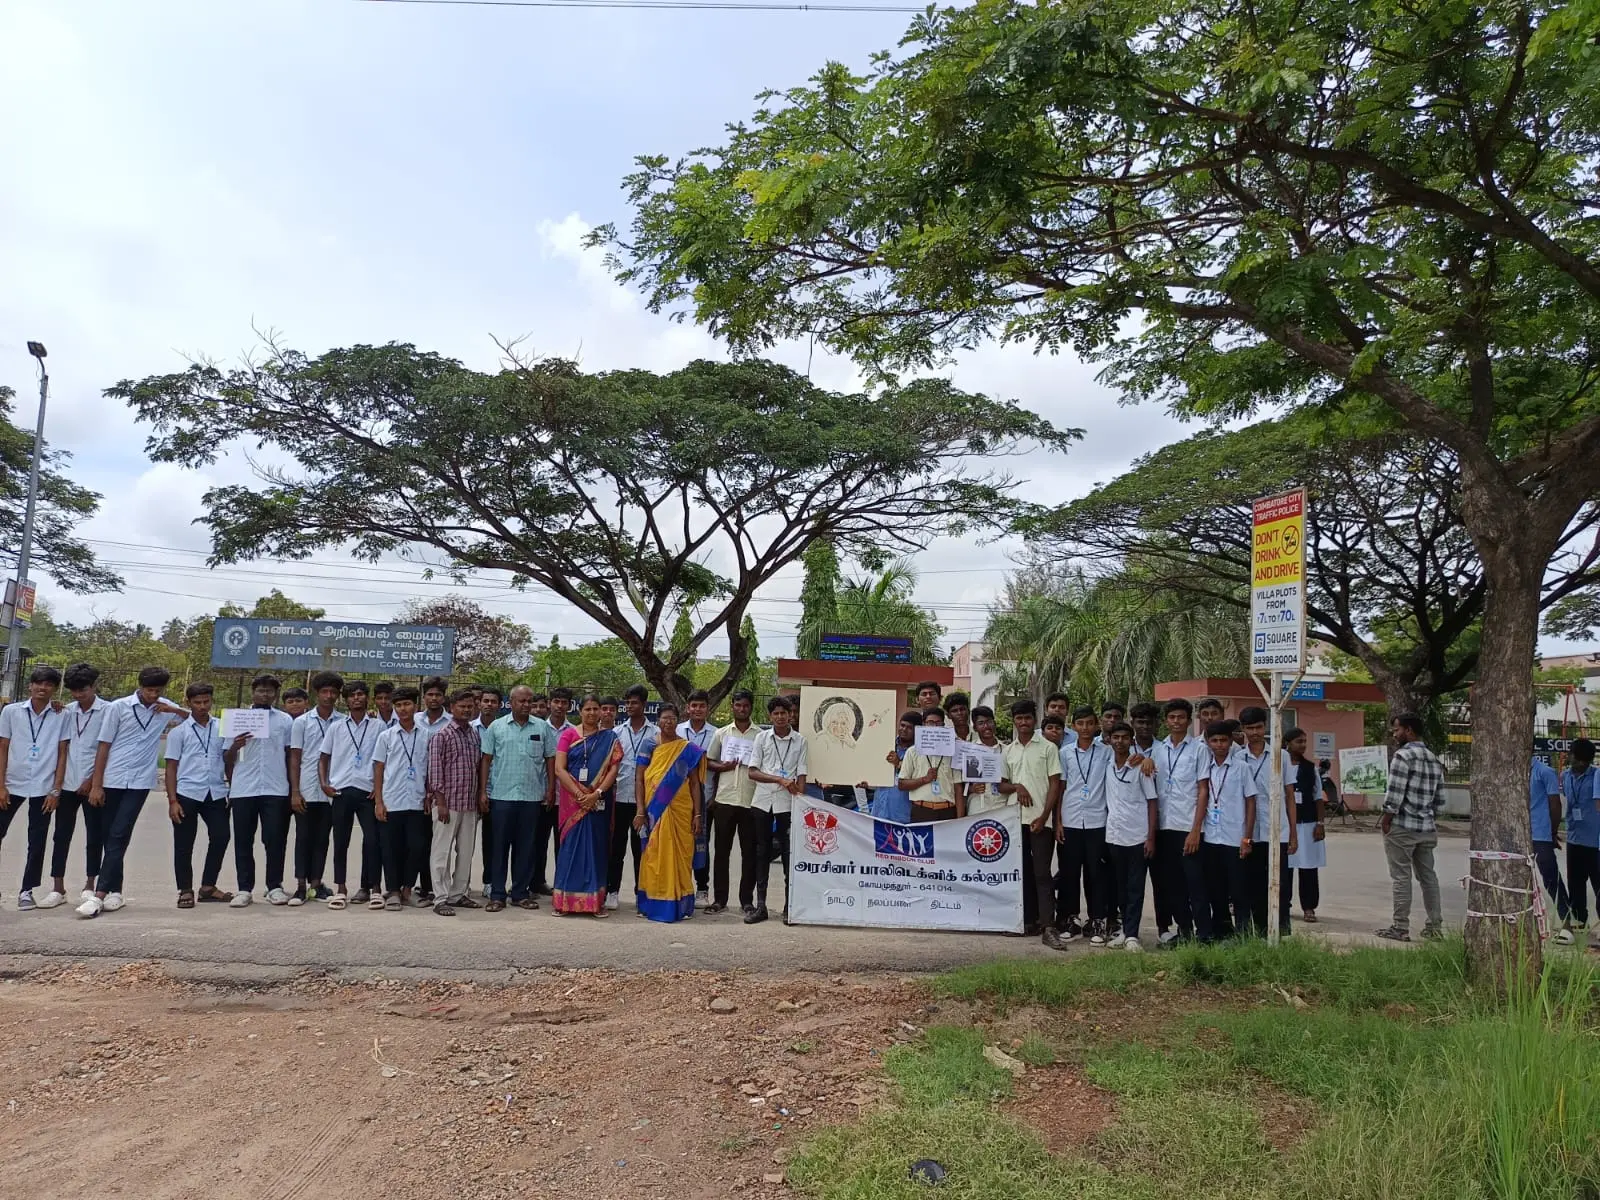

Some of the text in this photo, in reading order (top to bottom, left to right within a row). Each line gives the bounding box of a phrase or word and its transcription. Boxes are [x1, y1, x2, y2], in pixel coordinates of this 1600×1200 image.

[1254, 492, 1302, 512] COIMBATORE CITY
[1256, 504, 1298, 521] TRAFFIC POLICE
[1256, 529, 1280, 546] DON'T
[1256, 547, 1280, 563] DRINK
[1255, 561, 1299, 581] AND DRIVE
[1257, 587, 1296, 600] VILLA PLOTS
[1266, 600, 1285, 609] FROM
[259, 623, 445, 641] மண்டல அறிவியல் மையம்
[1267, 632, 1297, 644] SQUARE
[257, 645, 443, 661] REGIONAL SCIENCE CENTRE
[380, 661, 443, 670] COIMBATORE
[794, 861, 1020, 887] அரசினர் பாலிடெக்னிக் கல்லூரி
[827, 895, 855, 907] நாட்டு
[930, 900, 962, 910] திட்டம்
